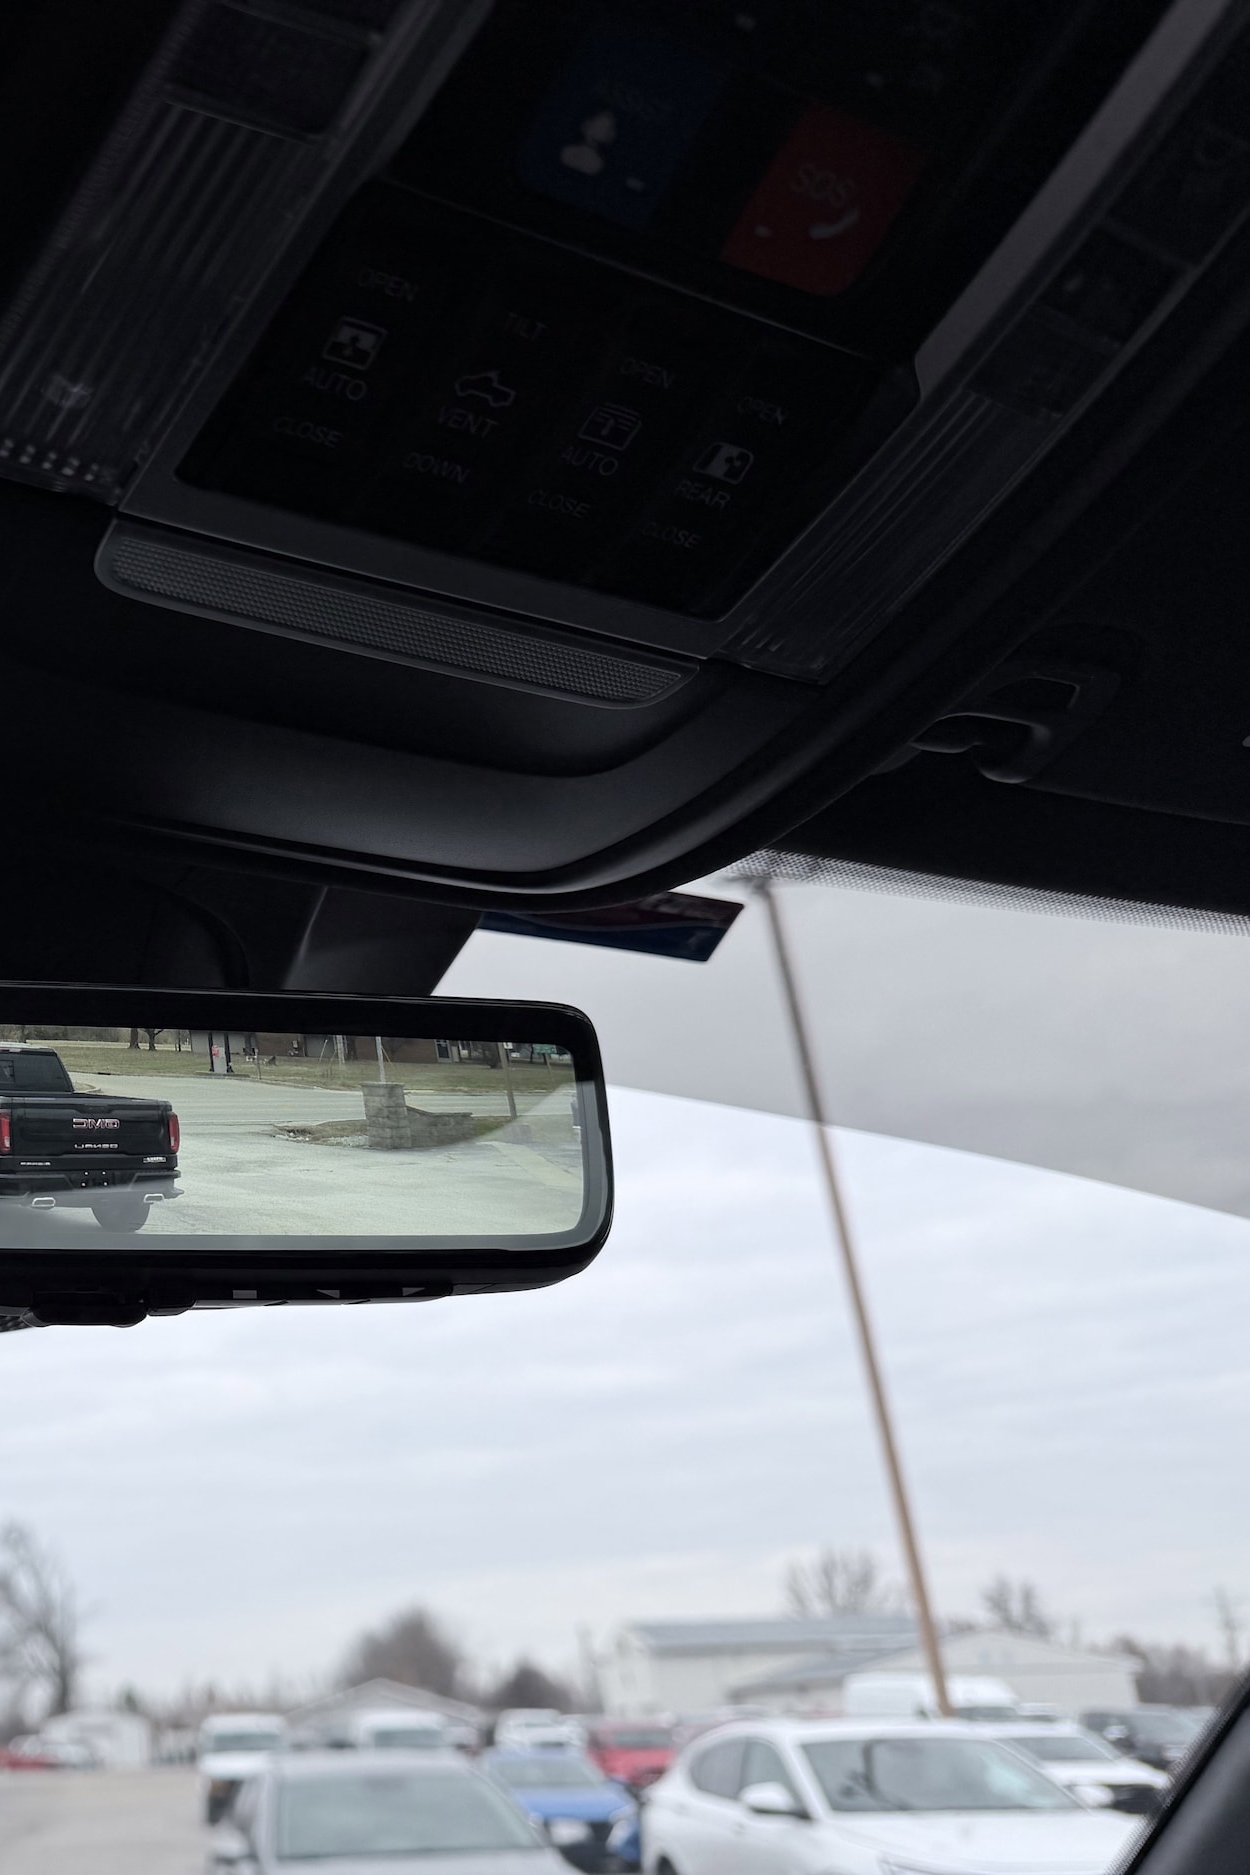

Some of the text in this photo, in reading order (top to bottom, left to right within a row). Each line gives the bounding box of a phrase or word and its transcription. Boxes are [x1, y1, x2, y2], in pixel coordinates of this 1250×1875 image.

[788, 162, 857, 208] SOS
[356, 265, 420, 303] OPEN
[502, 310, 548, 341] TILT
[302, 365, 368, 402] AUTO
[619, 355, 676, 390] OPEN
[436, 403, 499, 438] VENT
[735, 395, 788, 427] OPEN
[270, 415, 345, 449] CLOSE
[402, 450, 472, 485] DOWN
[558, 444, 620, 477] AUTO
[526, 488, 592, 520] CLOSE
[673, 477, 732, 511] REAR
[641, 519, 703, 550] CLOSE
